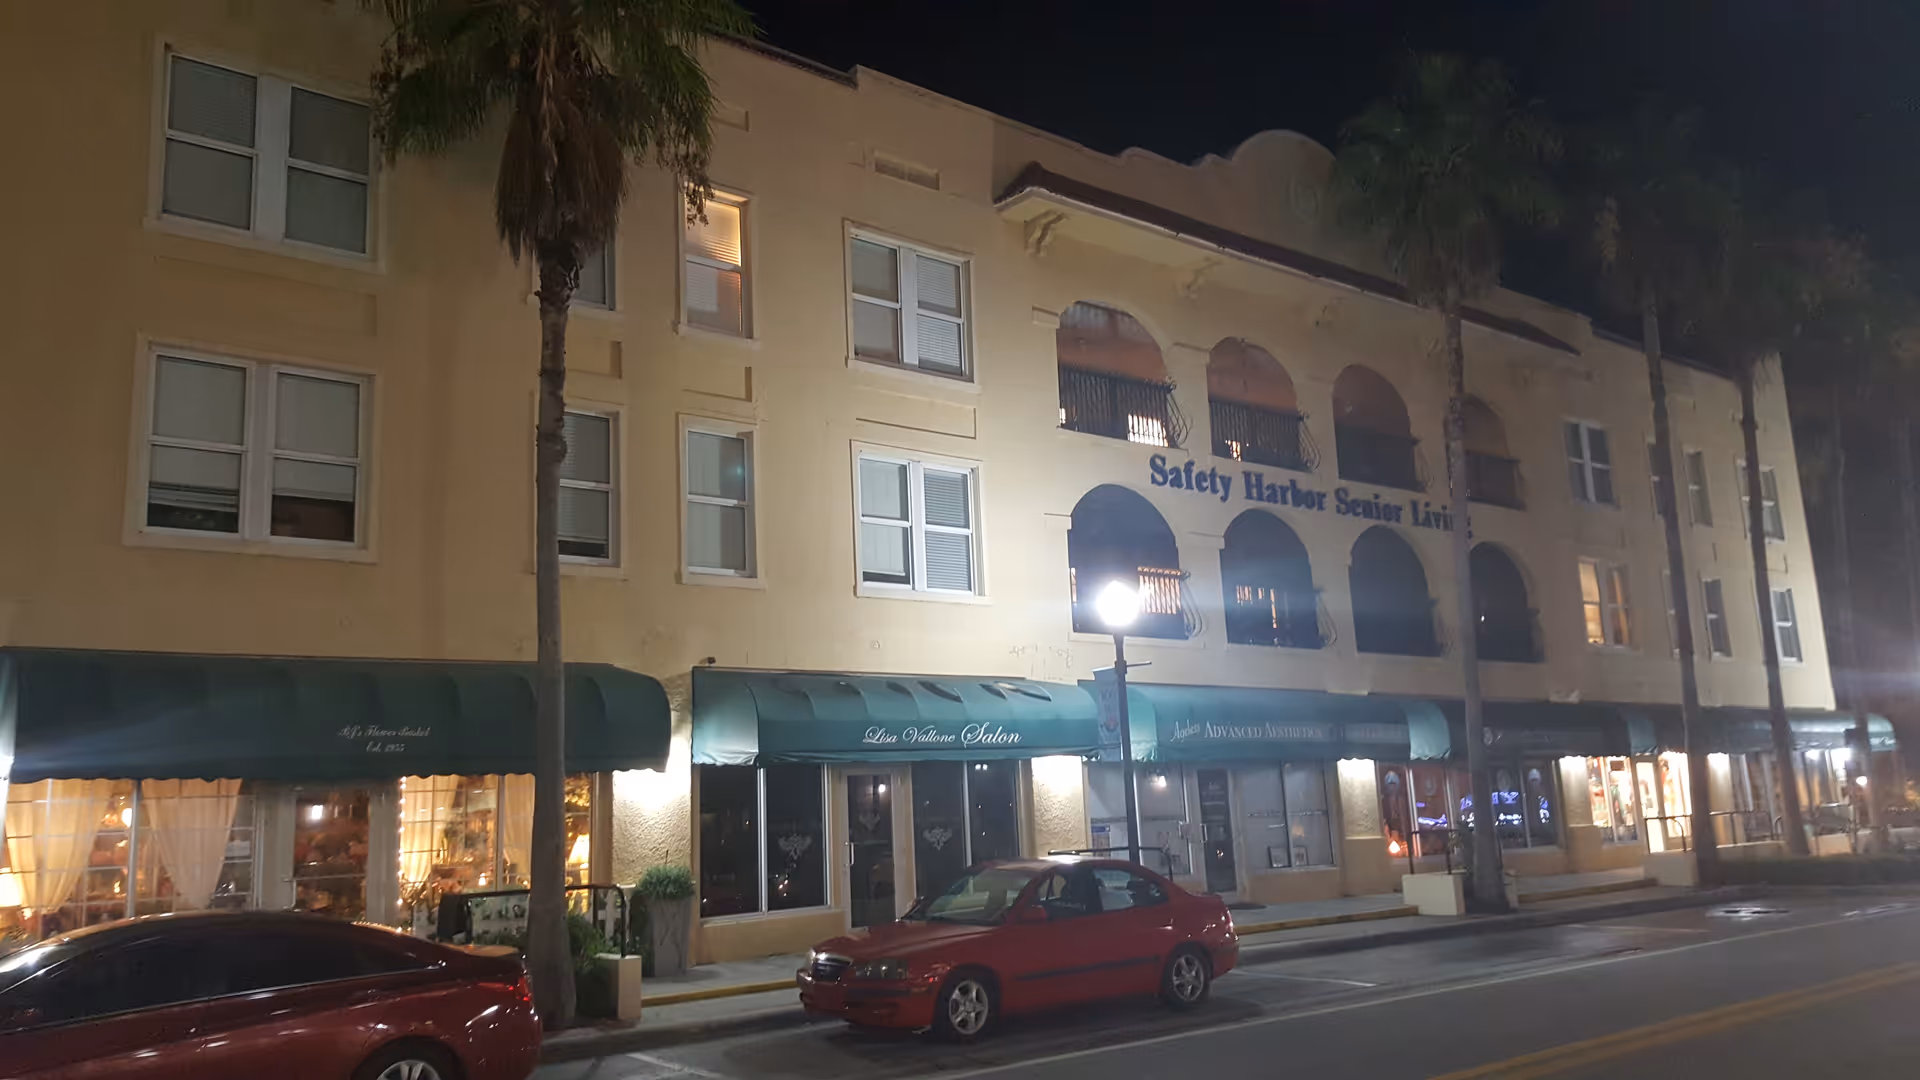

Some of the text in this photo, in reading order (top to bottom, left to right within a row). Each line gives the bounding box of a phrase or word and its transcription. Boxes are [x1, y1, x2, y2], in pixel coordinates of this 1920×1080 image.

[1149, 453, 1474, 540] Safety Harbor Senior Livi
[863, 722, 1022, 748] Lisa Vallone Salon
[1204, 720, 1262, 738] ADVANCED
